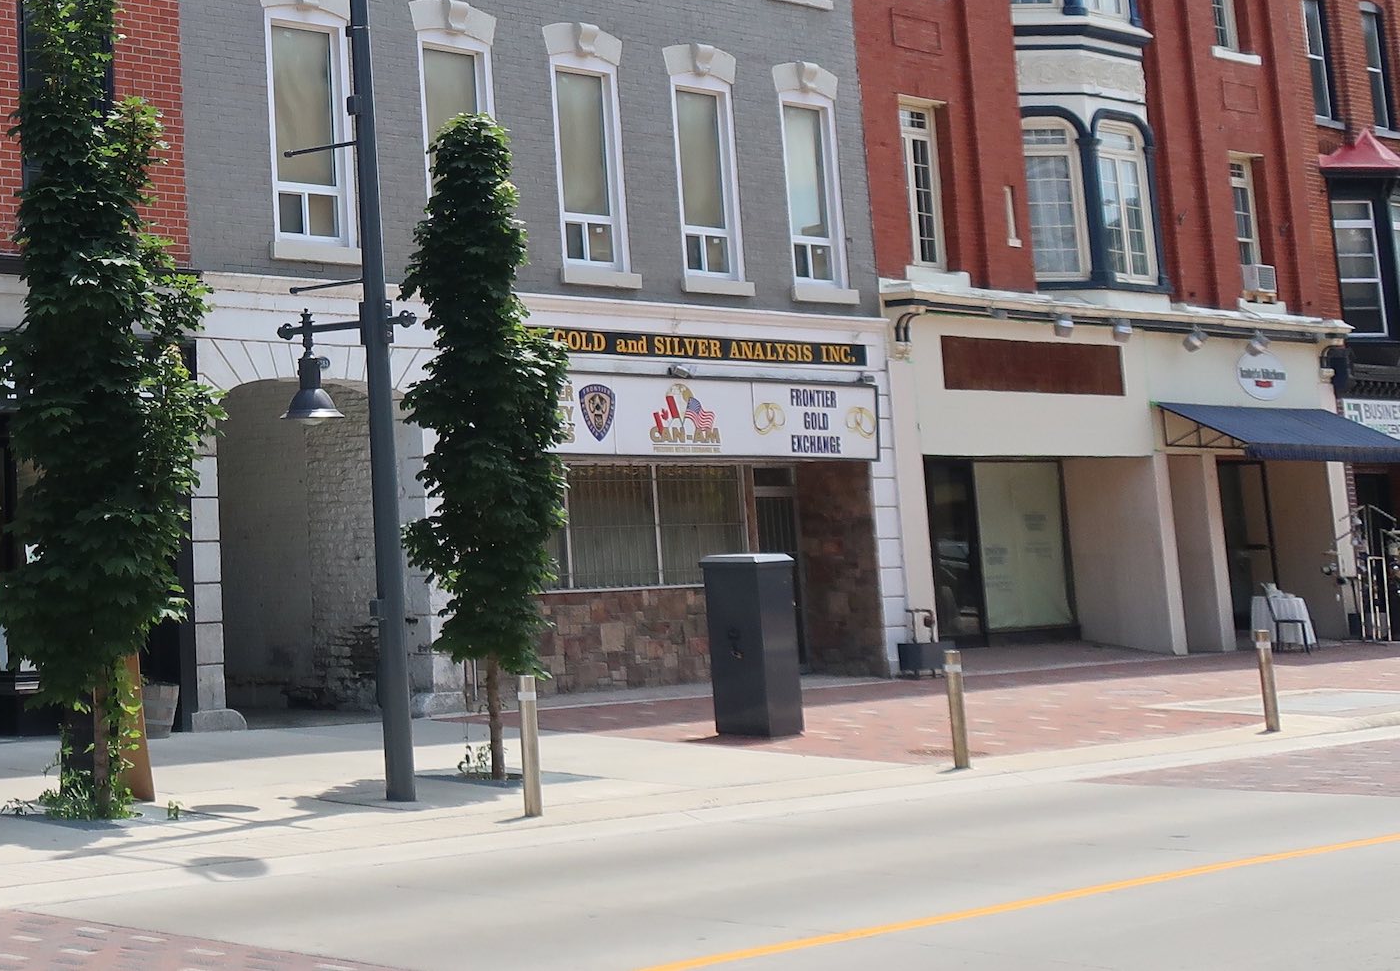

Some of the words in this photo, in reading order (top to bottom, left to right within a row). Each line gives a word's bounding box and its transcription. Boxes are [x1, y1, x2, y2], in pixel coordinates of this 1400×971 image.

[553, 329, 606, 351] GOLD
[616, 335, 649, 354] and
[653, 335, 722, 358] SILVER
[729, 340, 814, 363] ANALYSIS
[820, 345, 857, 364] INC.
[790, 388, 837, 408] FRONTIER
[803, 412, 829, 430] GOLD
[1363, 403, 1400, 420] BUSINE
[649, 426, 720, 443] CAN-AM
[791, 434, 841, 454] EXCHANGE
